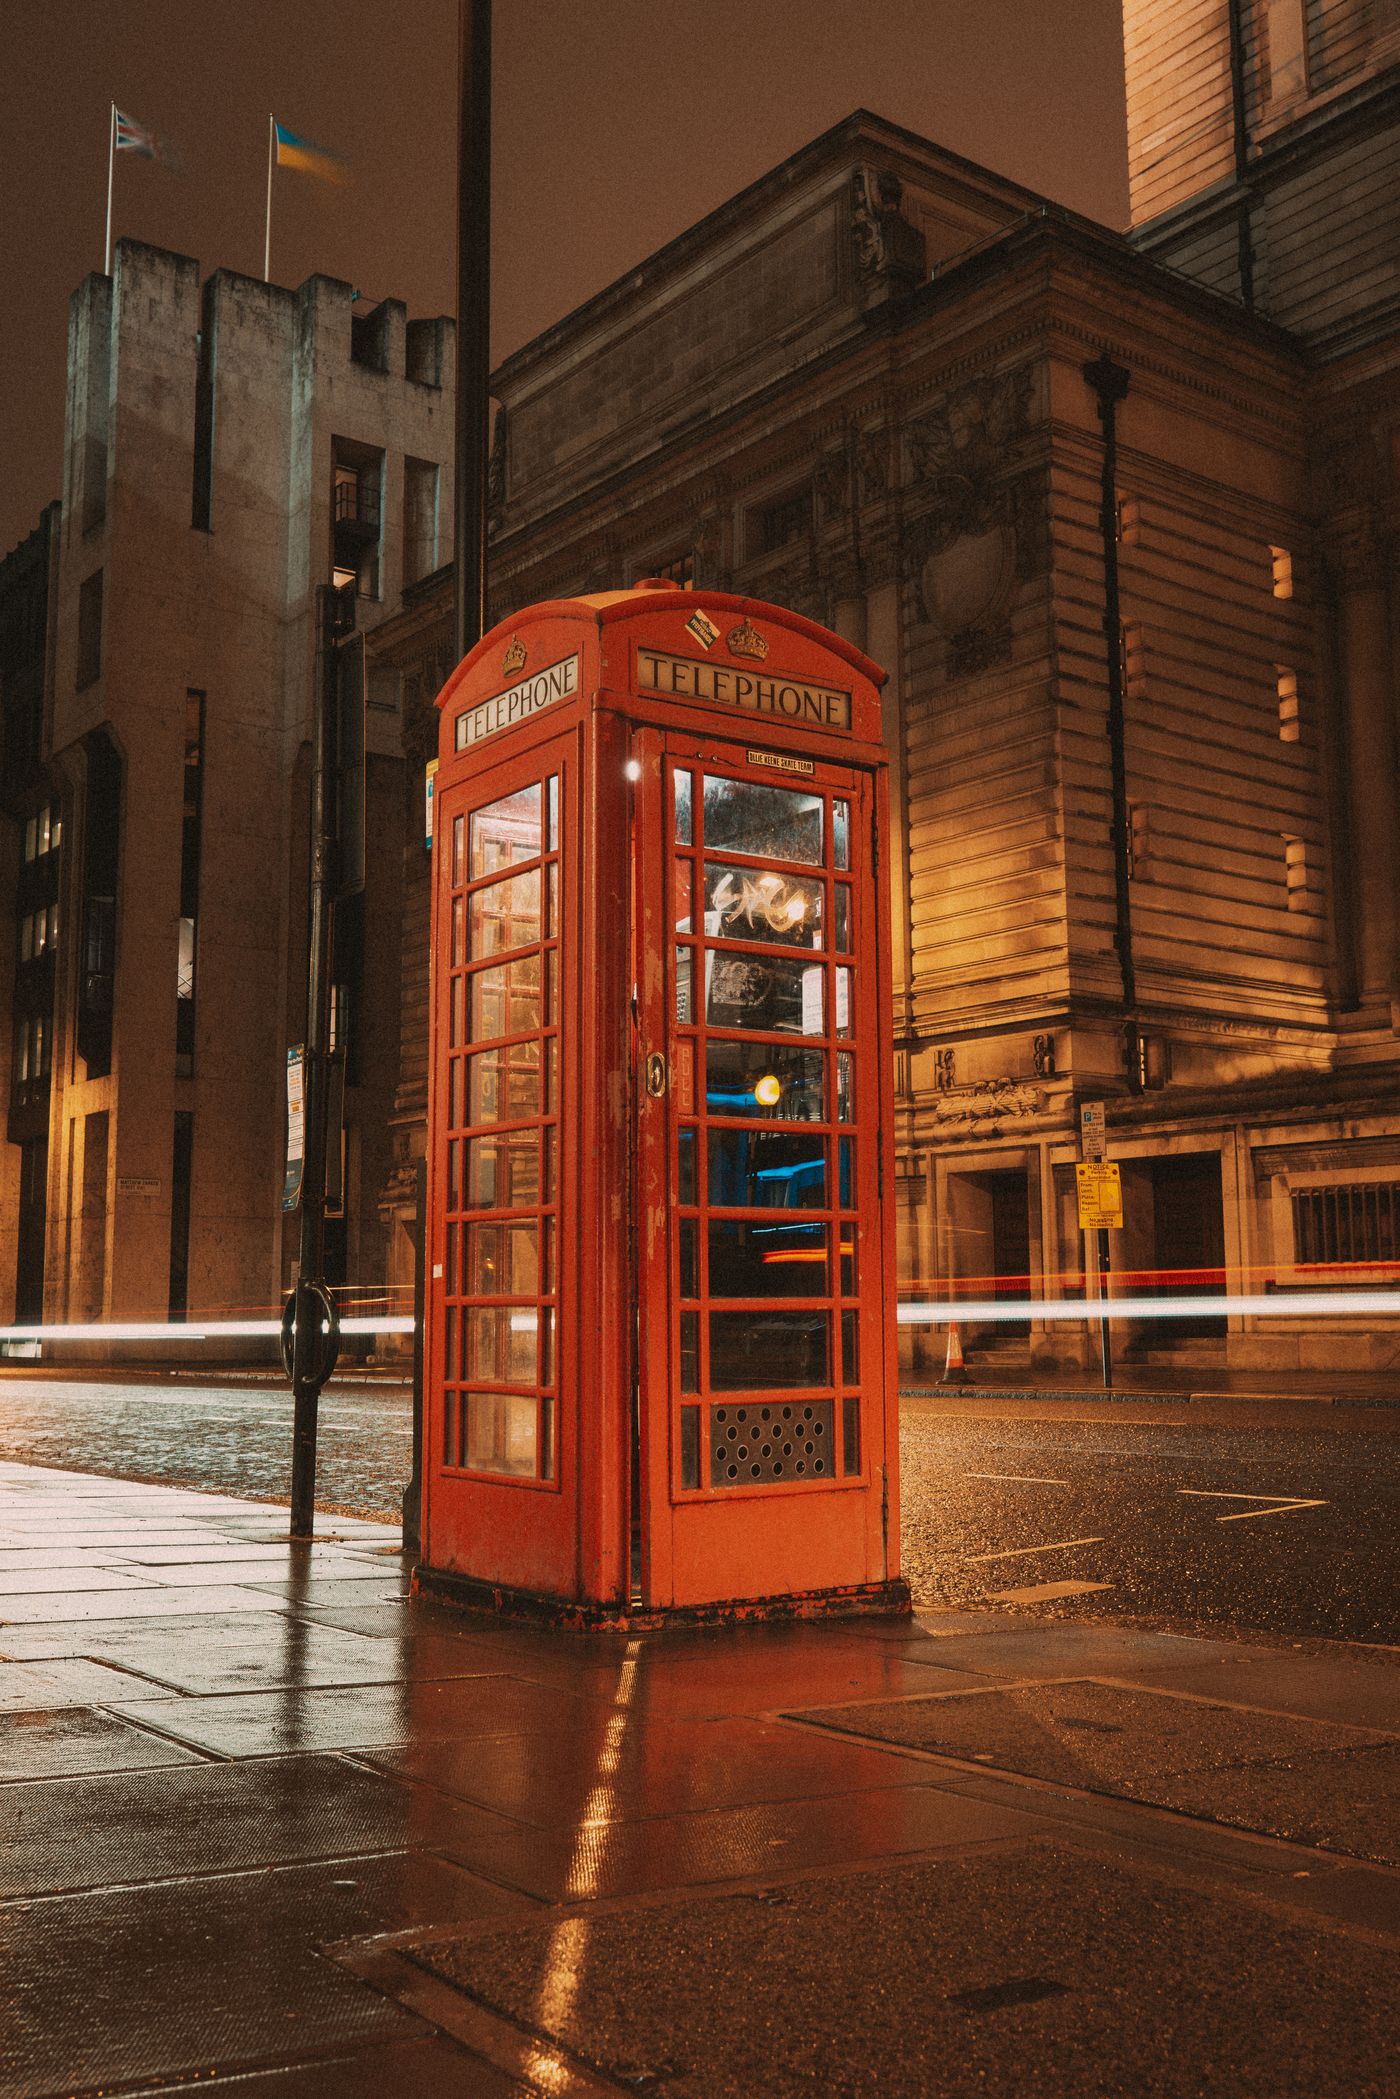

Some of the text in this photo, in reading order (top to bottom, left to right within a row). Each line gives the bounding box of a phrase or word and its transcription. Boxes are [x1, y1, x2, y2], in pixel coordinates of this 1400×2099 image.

[461, 660, 574, 745] TELEPHONE
[645, 656, 841, 726] TELEPHONE
[781, 758, 797, 769] SKATE
[797, 761, 812, 772] TEAM
[682, 1047, 690, 1106] PULL
